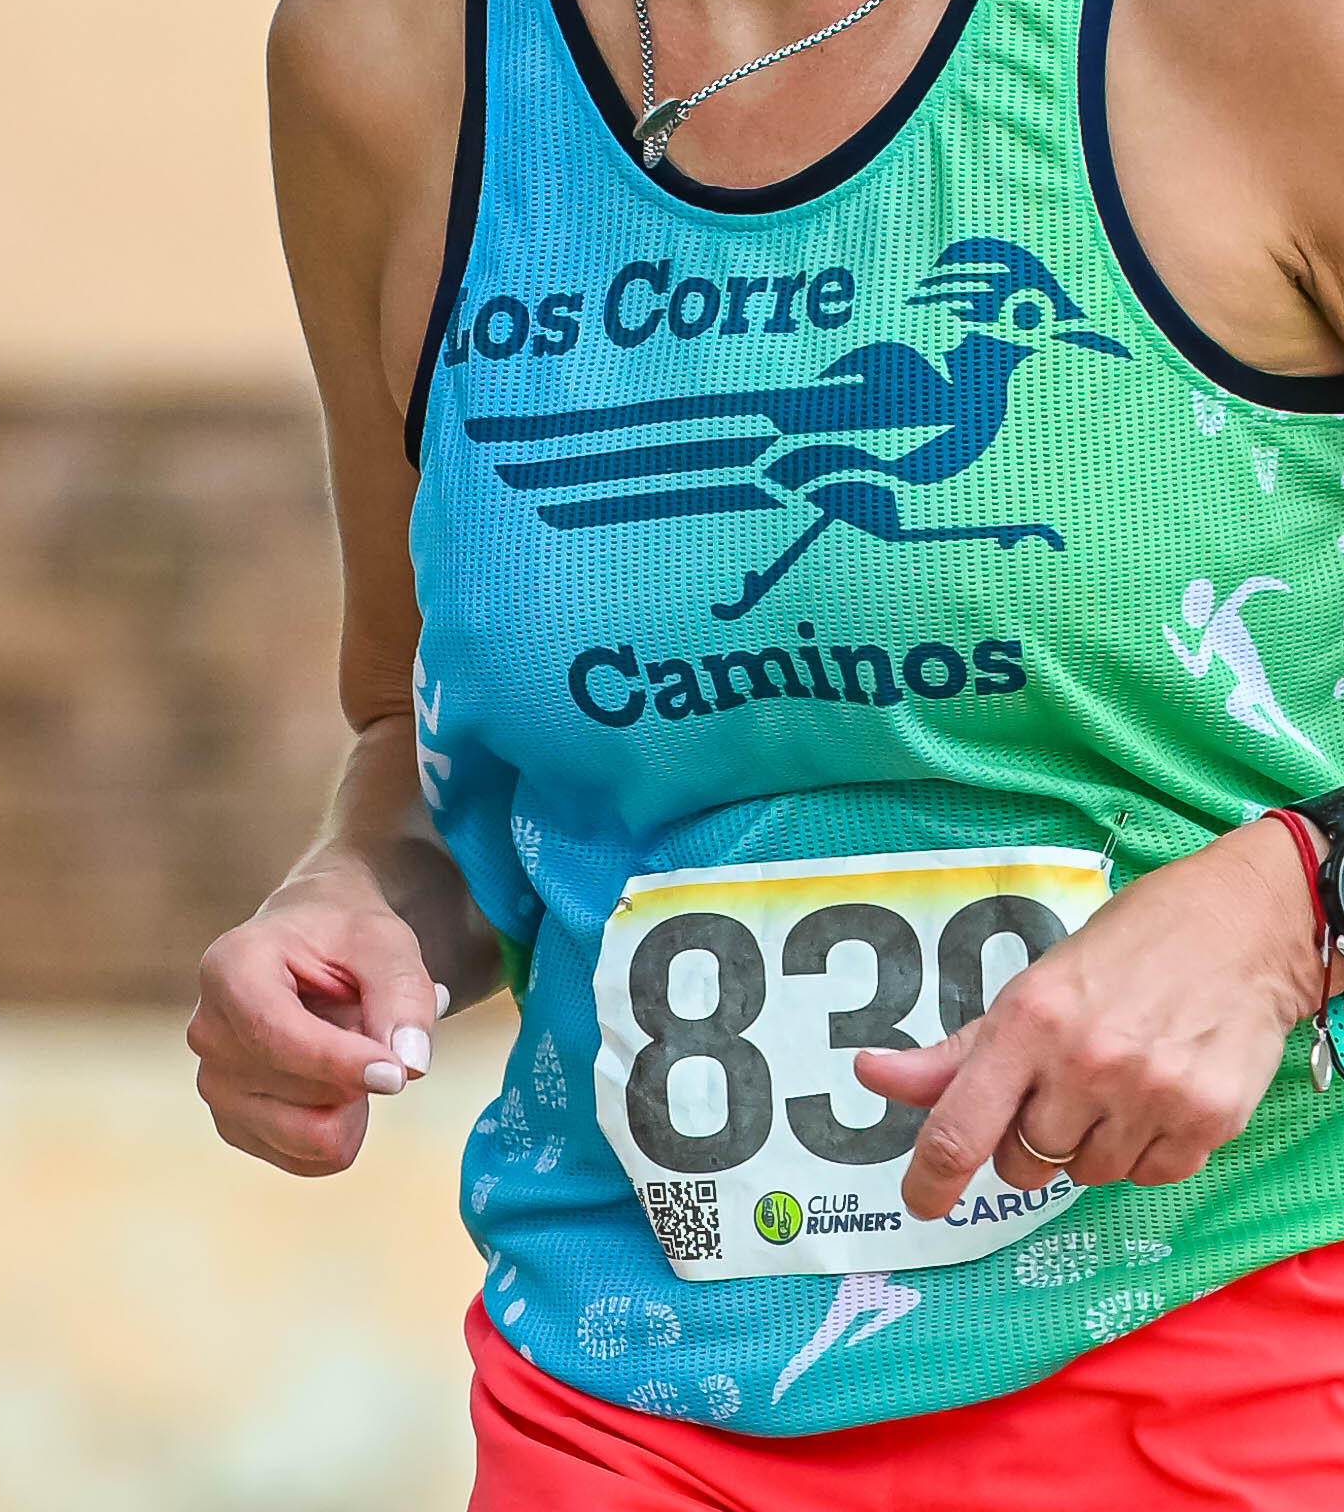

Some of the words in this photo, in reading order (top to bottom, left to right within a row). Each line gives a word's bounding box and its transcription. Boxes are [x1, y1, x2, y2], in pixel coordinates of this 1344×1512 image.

[603, 258, 856, 349] Corre
[568, 621, 1027, 728] Caminos
[806, 1212, 902, 1235] RUNNER'S
[807, 1194, 859, 1214] CLUB
[943, 1179, 1082, 1227] CARUS
